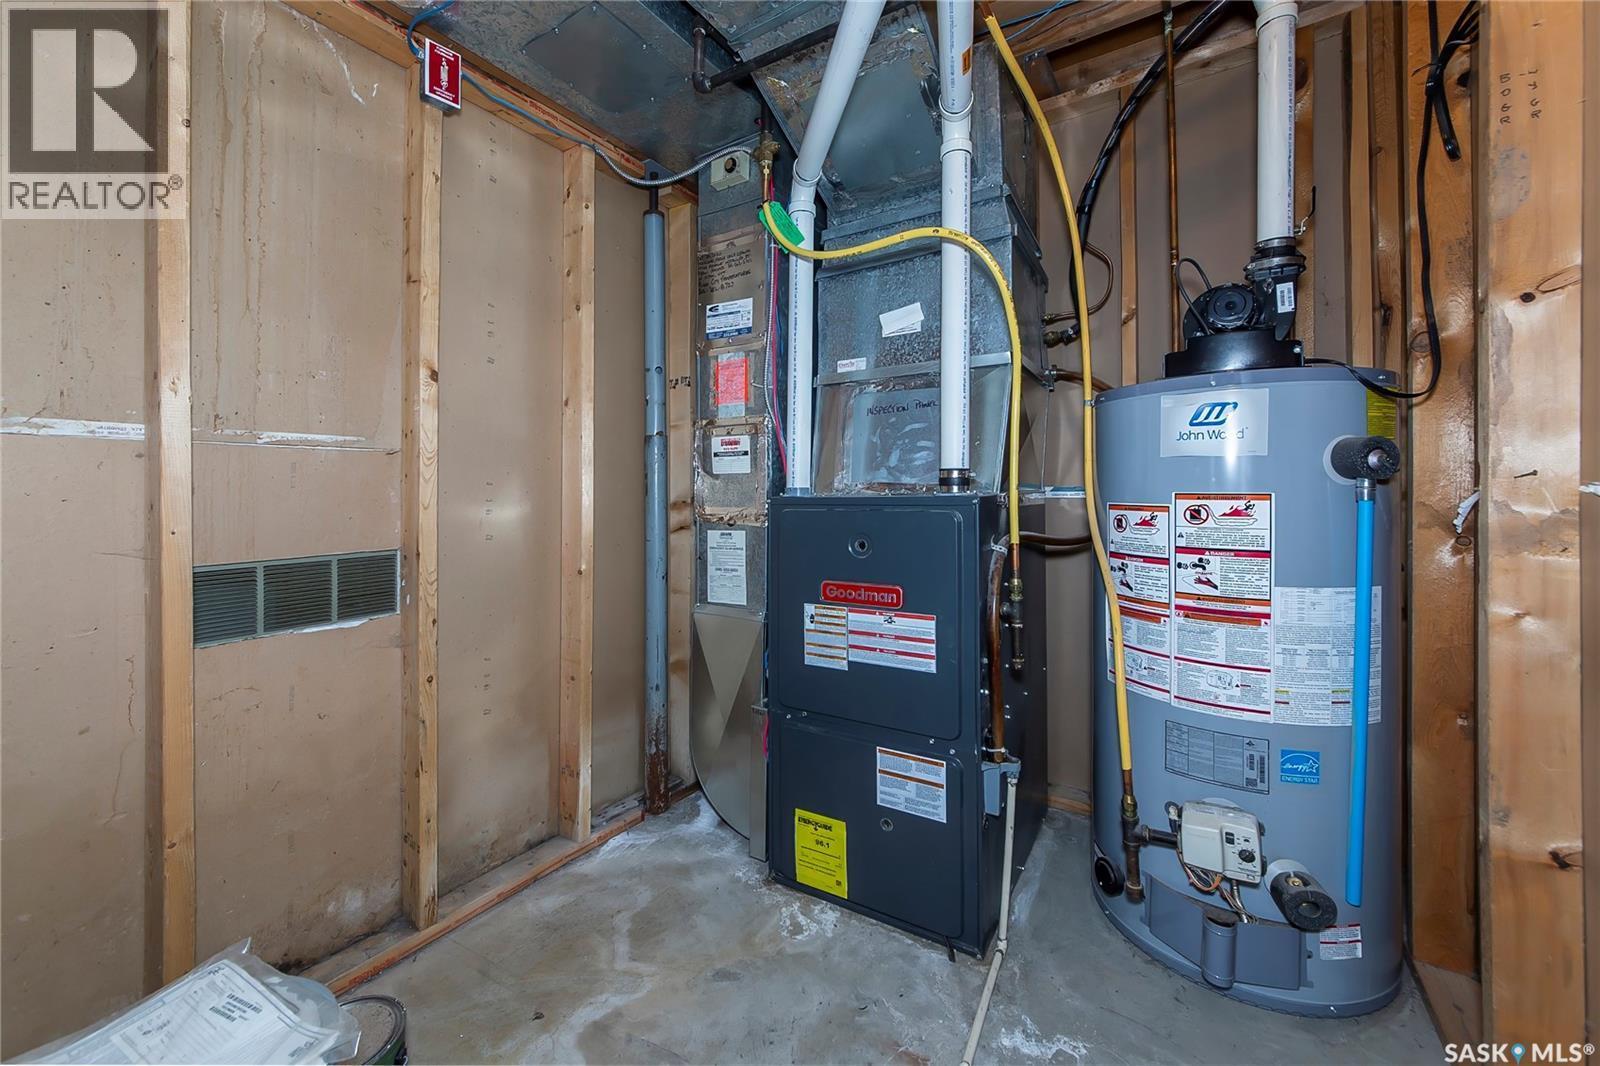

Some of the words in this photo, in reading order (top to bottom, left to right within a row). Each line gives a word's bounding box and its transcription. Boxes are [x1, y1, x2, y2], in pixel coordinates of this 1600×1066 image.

[866, 403, 909, 416] INSPECTION
[1176, 431, 1205, 442] John
[1207, 428, 1245, 441] Wod
[826, 585, 897, 604] Goodman
